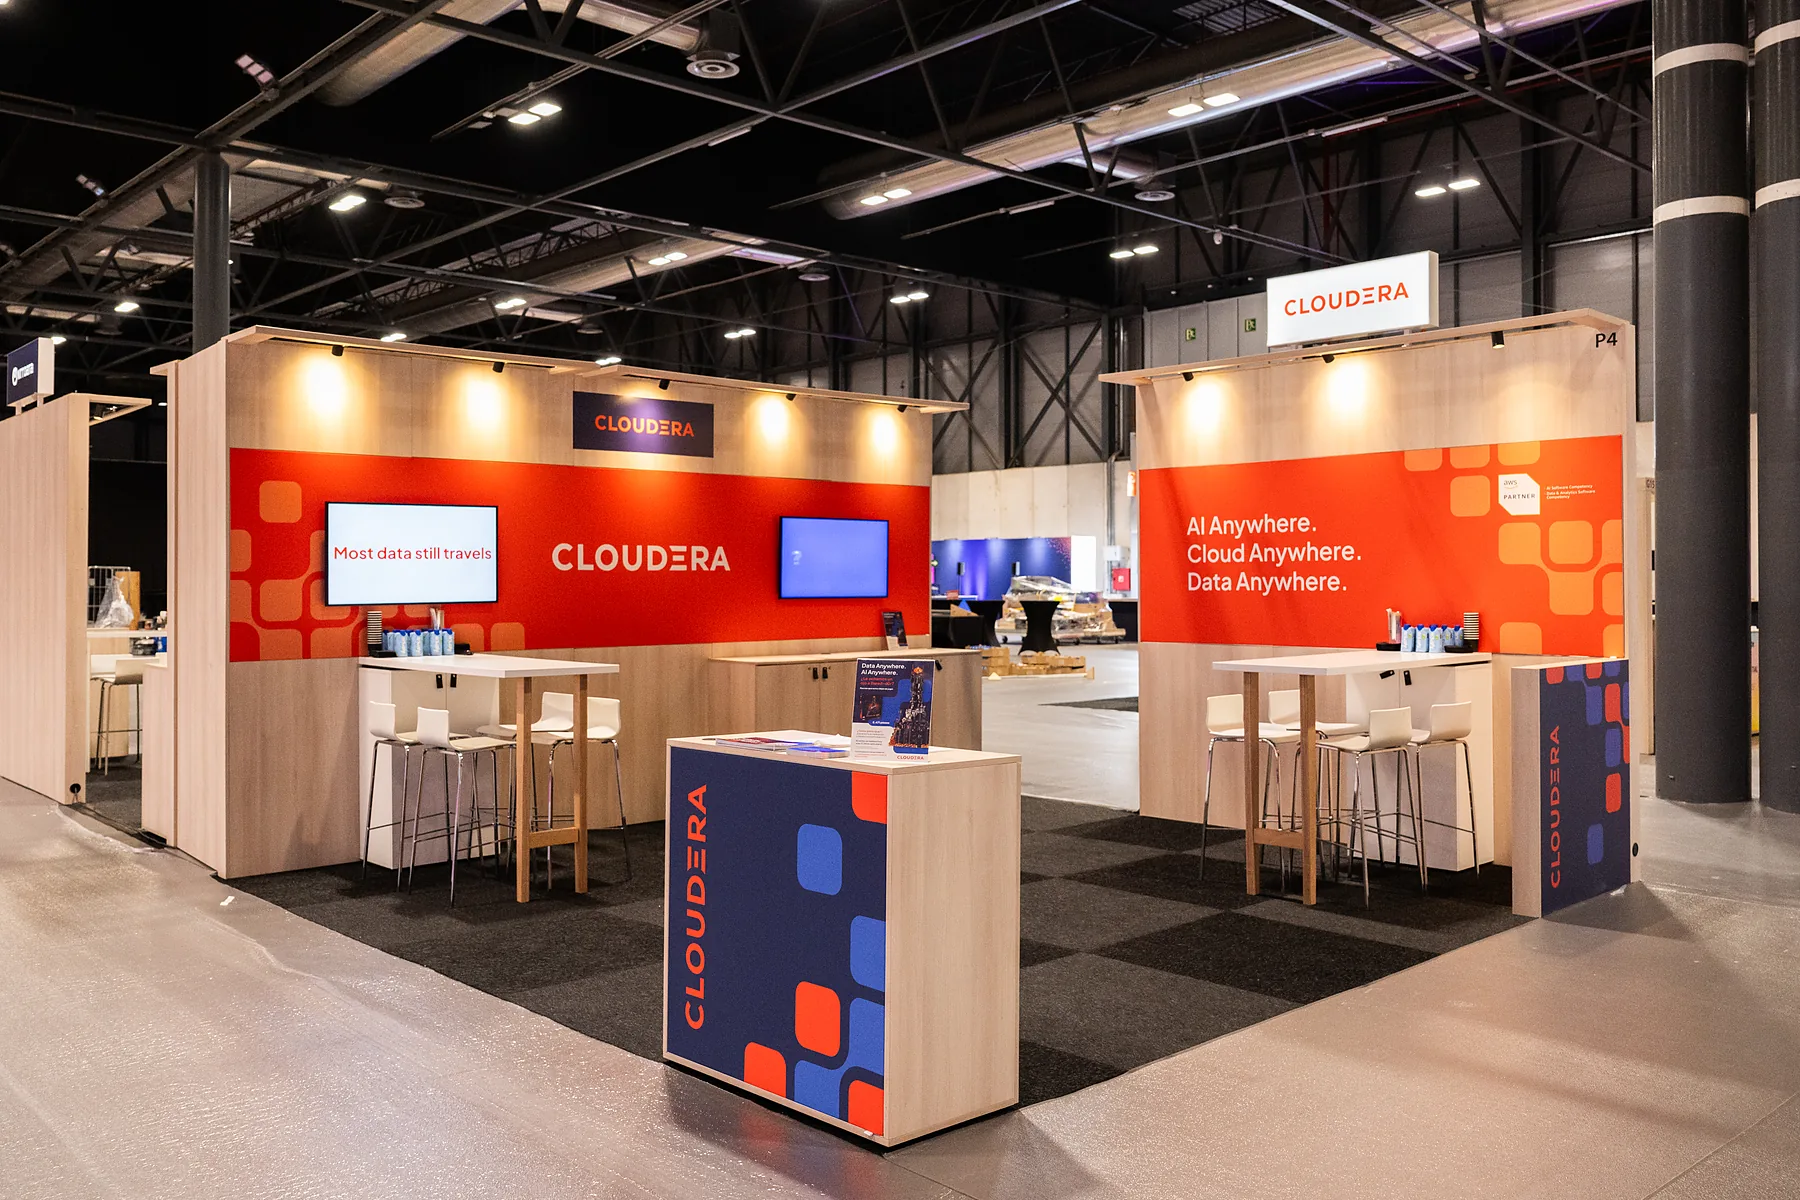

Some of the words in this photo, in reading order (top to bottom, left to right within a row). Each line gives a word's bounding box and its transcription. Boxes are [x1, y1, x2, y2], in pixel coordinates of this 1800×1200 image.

[1284, 282, 1409, 316] CLOUDERA
[1595, 331, 1618, 348] P4
[594, 414, 695, 437] CLOUDERA
[1187, 516, 1205, 536] AI
[1209, 513, 1317, 540] Anywhere.
[334, 546, 374, 560] Most
[377, 547, 412, 560] data
[415, 547, 440, 560] still
[443, 547, 492, 560] travels
[552, 543, 731, 572] CLOUDERA
[1187, 543, 1245, 564] Cloud
[1249, 541, 1362, 568] Anywhere.
[1187, 572, 1232, 592] Data
[1235, 571, 1347, 597] Anywhere.
[1550, 725, 1561, 888] CLOUDERA
[684, 785, 707, 1030] CLOUDERA
